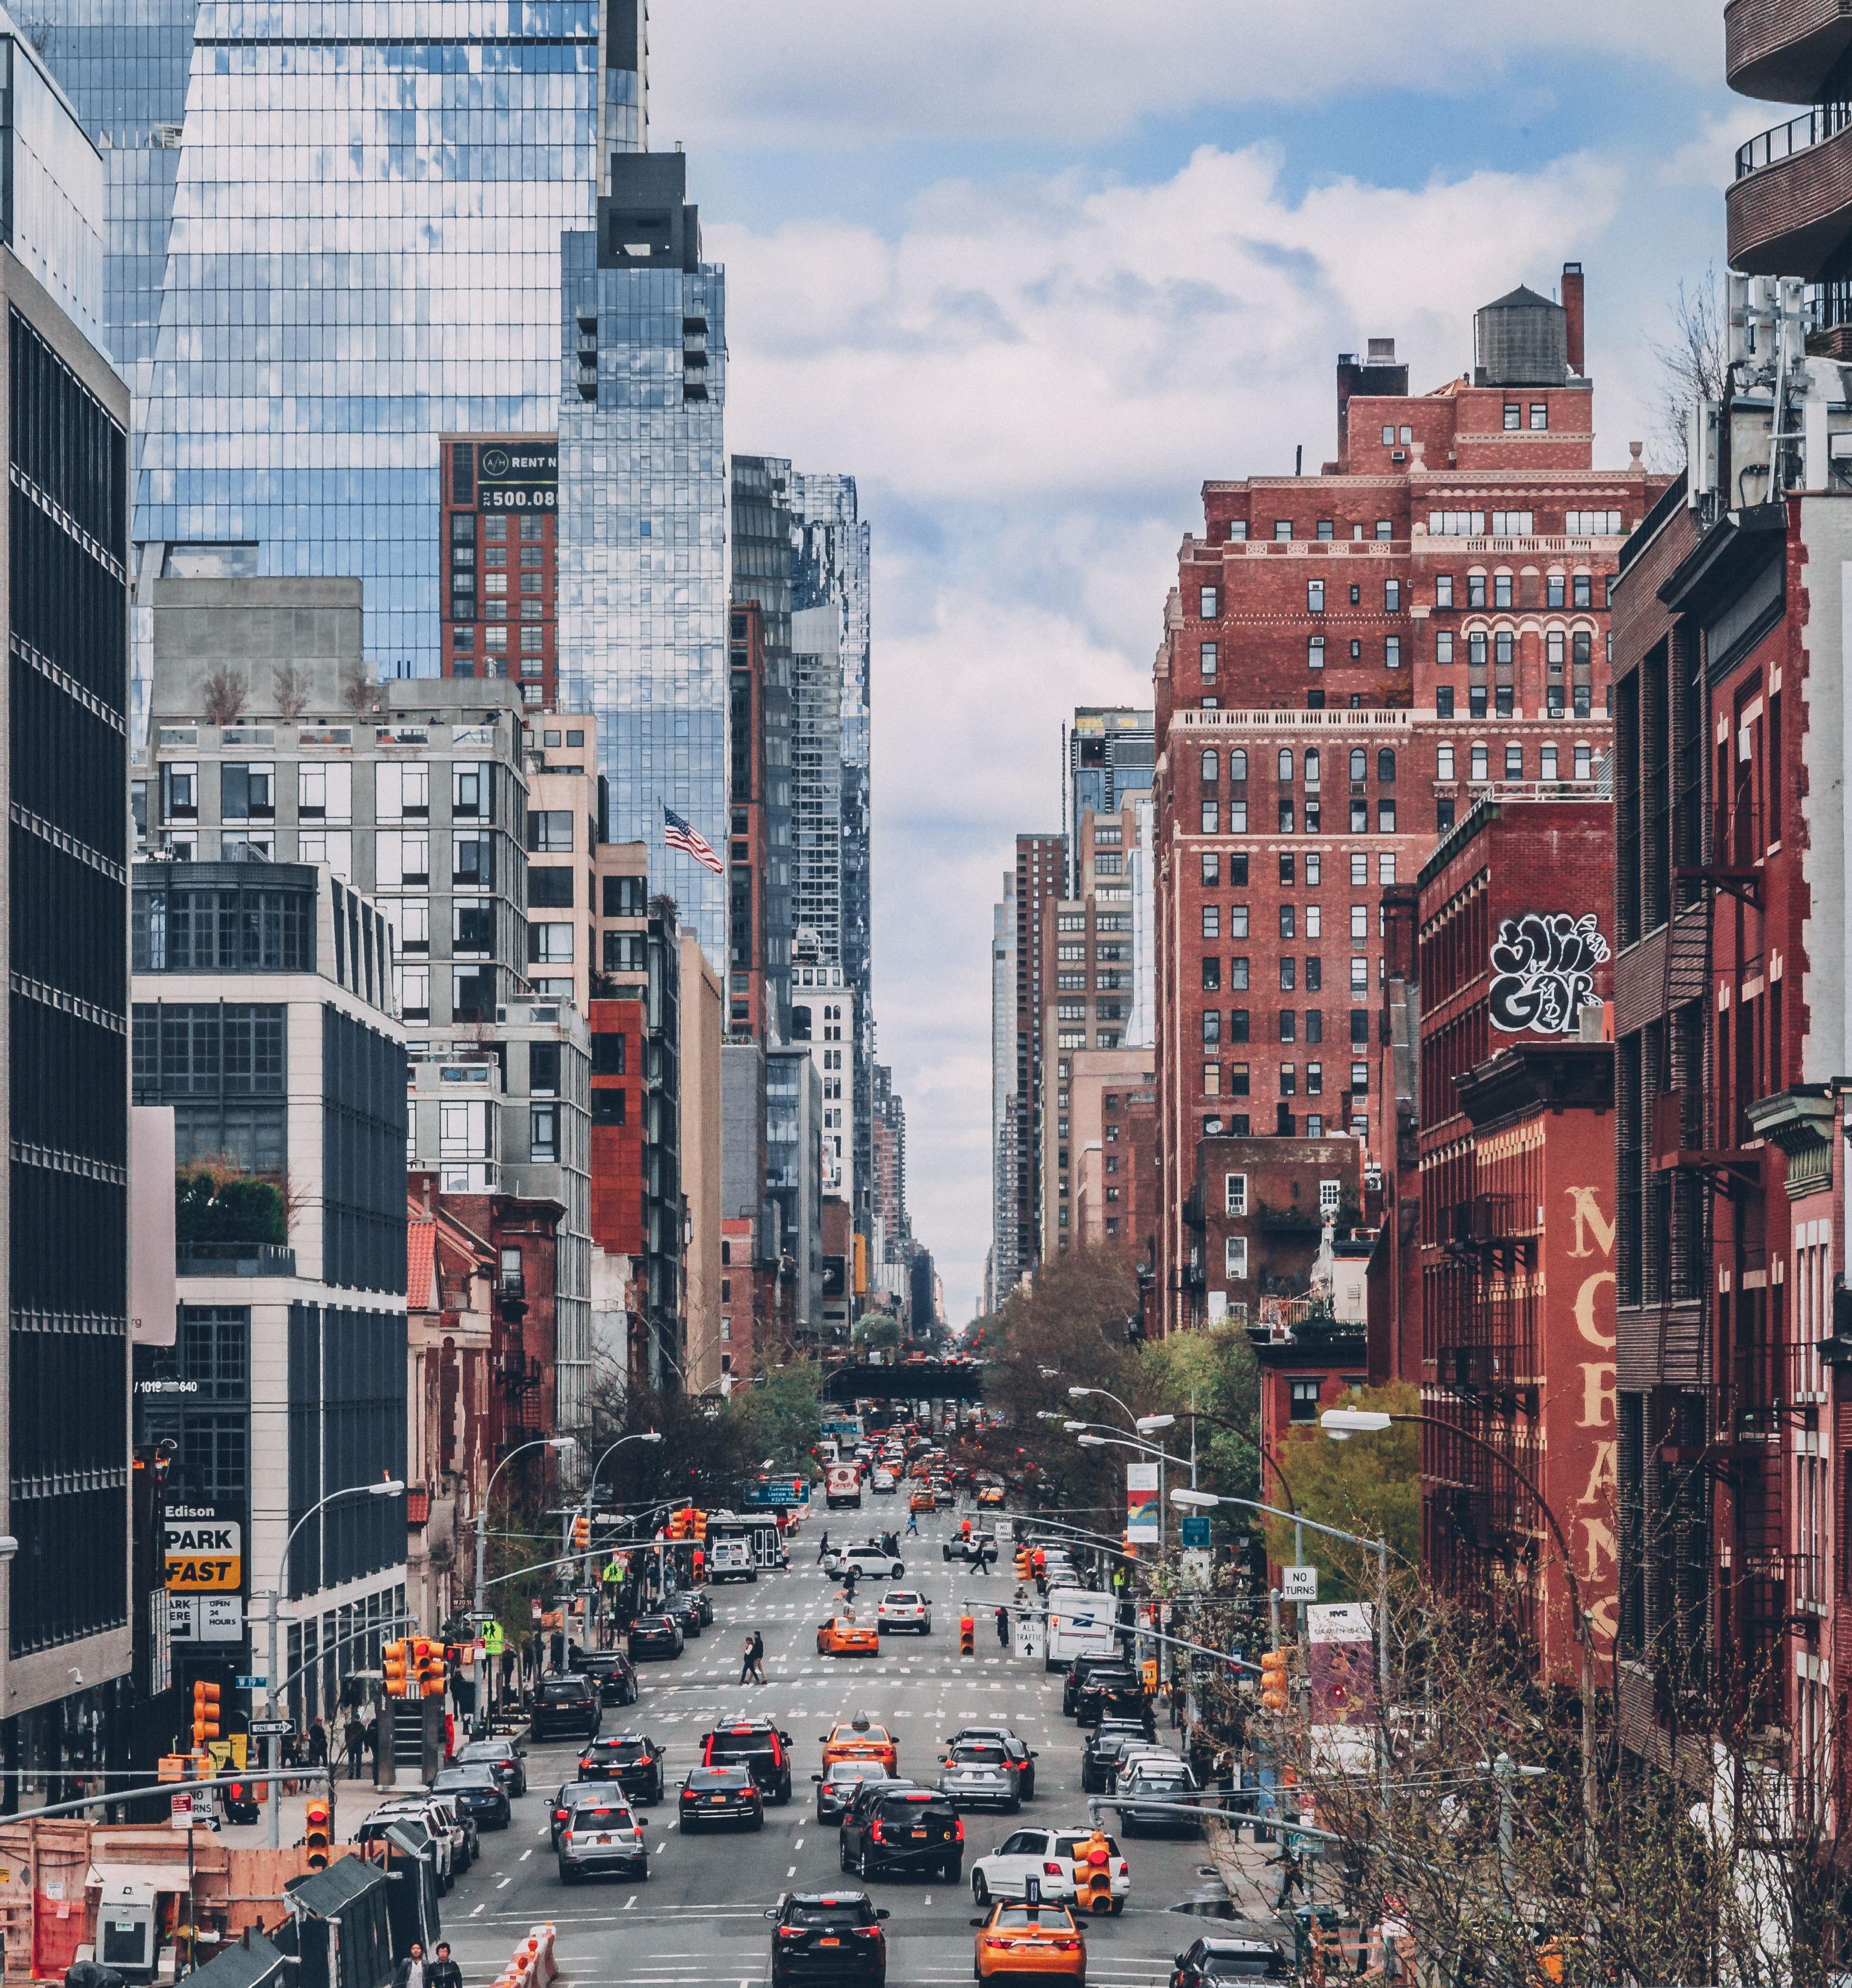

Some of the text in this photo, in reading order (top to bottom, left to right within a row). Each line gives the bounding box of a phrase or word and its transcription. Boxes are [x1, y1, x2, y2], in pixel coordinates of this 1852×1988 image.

[512, 457, 545, 467] RENT
[493, 491, 559, 506] 500.08
[179, 1381, 197, 1392] 640
[165, 1505, 215, 1517] Edison
[165, 1530, 232, 1549] PARK
[166, 1561, 232, 1582] FAST
[1293, 1572, 1307, 1582] NO
[1285, 1586, 1315, 1595] TURNS
[1017, 1633, 1042, 1641] TRAFFIC
[239, 1678, 246, 1686] W
[248, 1678, 256, 1686] 19
